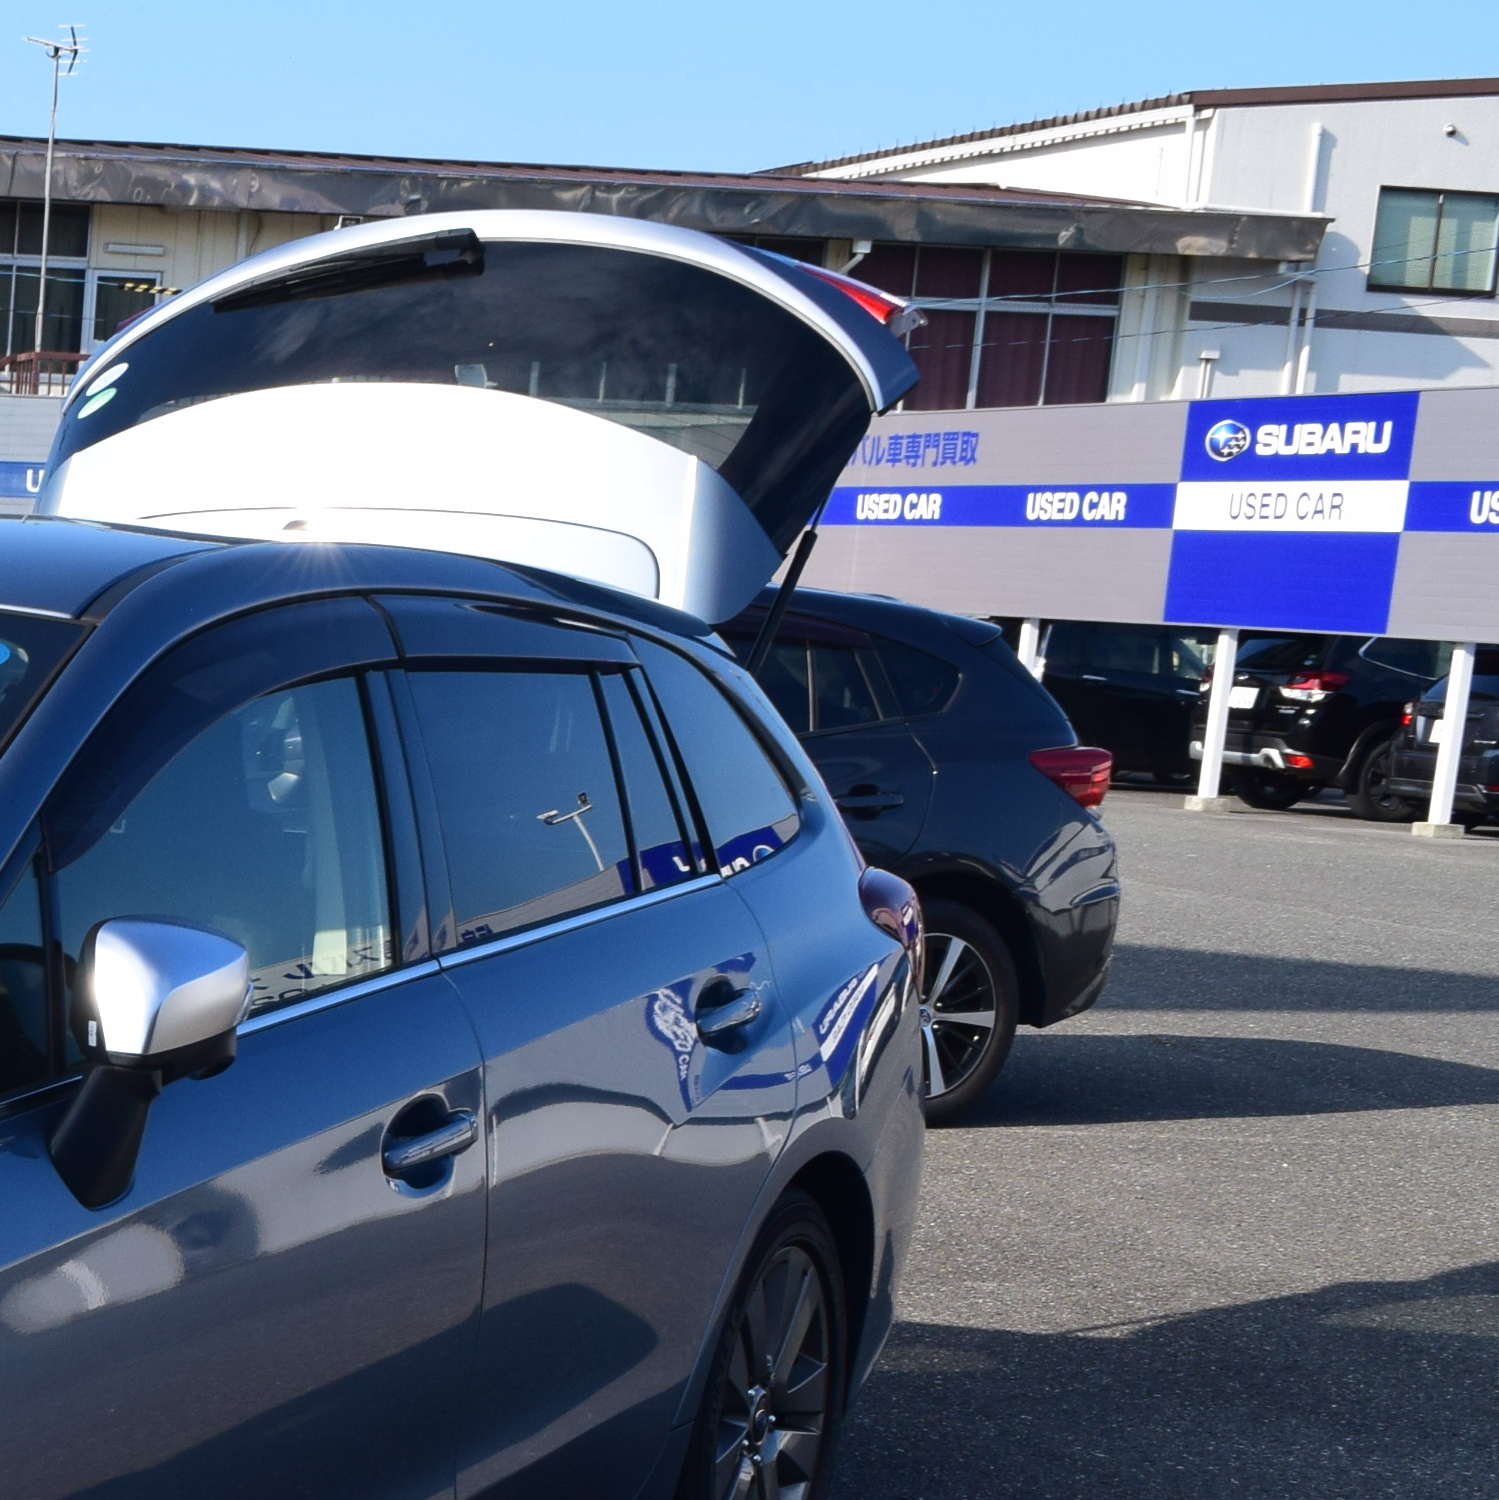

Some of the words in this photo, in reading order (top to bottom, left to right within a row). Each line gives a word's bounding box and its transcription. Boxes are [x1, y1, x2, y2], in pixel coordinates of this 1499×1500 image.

[1255, 420, 1393, 456] SUBARU
[856, 493, 902, 520] USED
[903, 493, 943, 520] CAR
[1026, 491, 1080, 521] USED
[1082, 491, 1127, 521] CAR
[1229, 492, 1289, 520] USED
[1295, 492, 1345, 521] CAR
